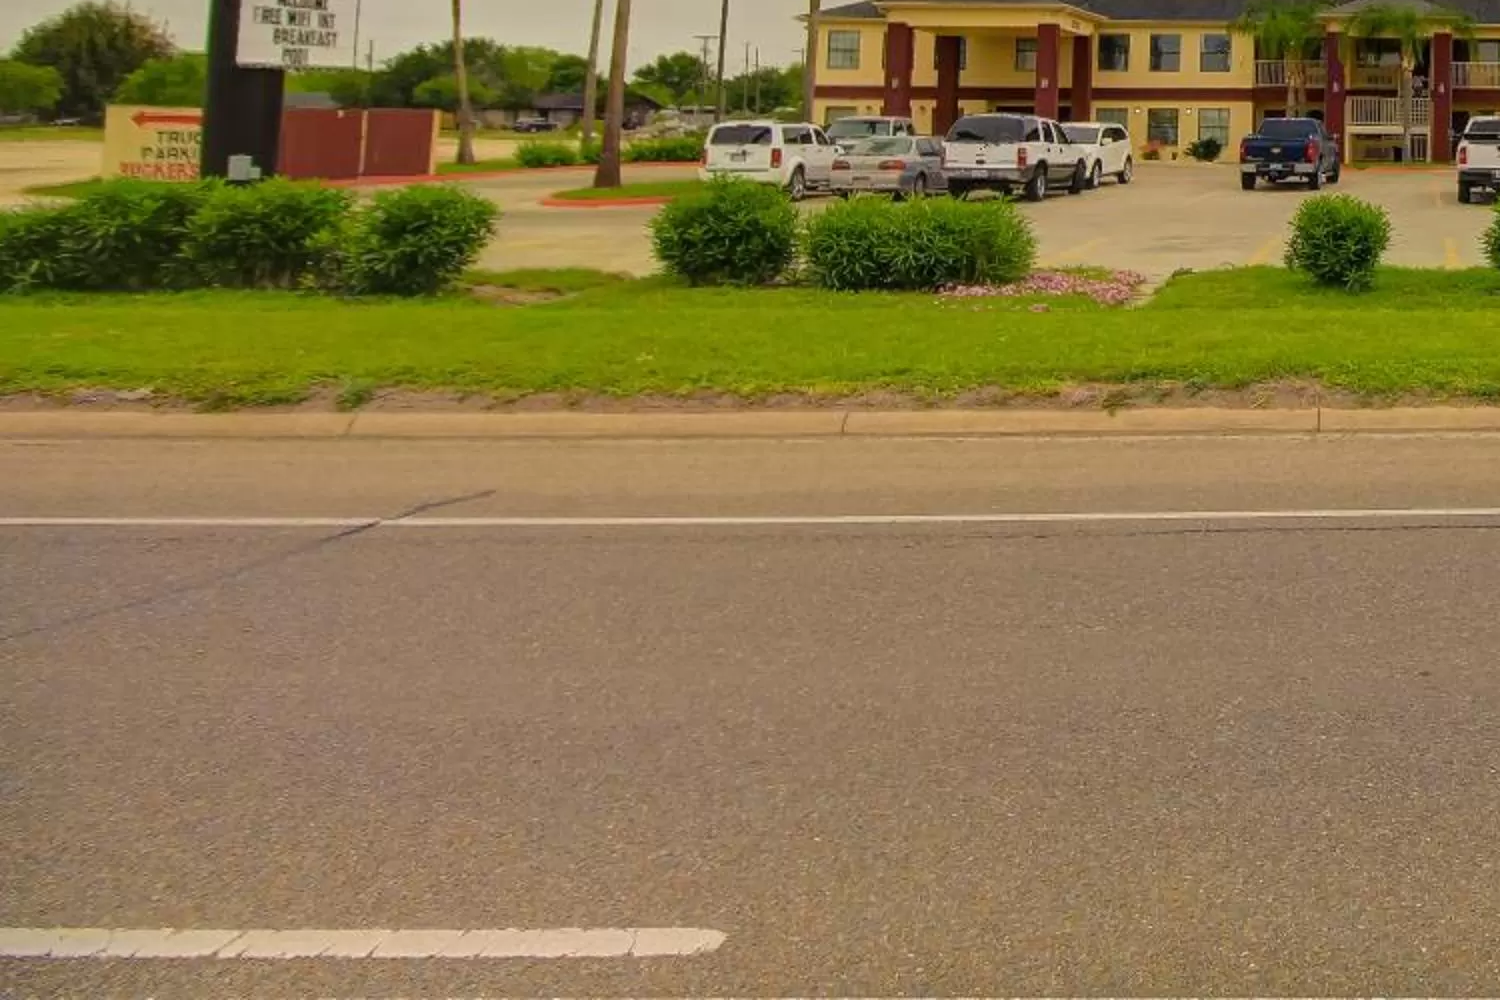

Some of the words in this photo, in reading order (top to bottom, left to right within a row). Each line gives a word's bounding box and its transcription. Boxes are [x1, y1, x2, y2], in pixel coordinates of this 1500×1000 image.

[253, 6, 282, 24] FREE
[273, 28, 337, 48] BREAKFAST
[157, 131, 202, 145] TRUC
